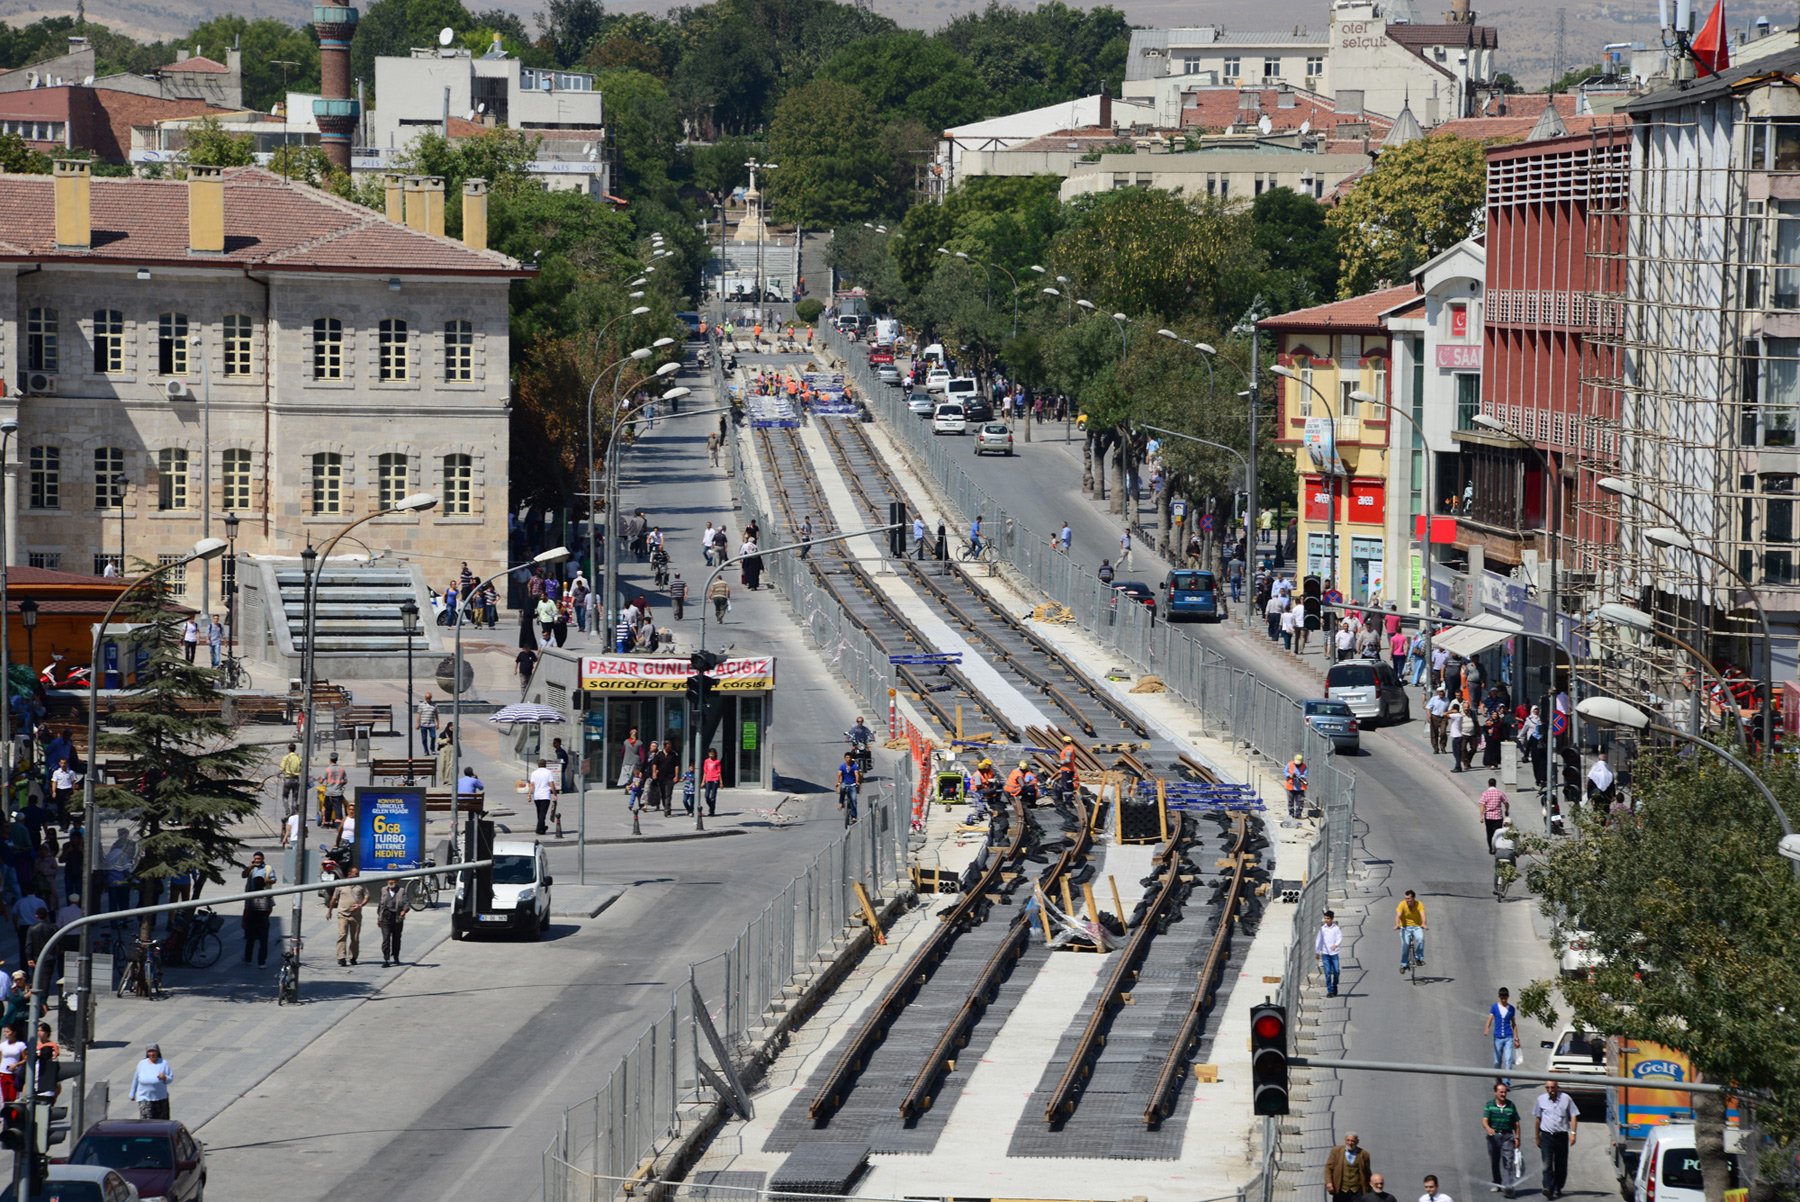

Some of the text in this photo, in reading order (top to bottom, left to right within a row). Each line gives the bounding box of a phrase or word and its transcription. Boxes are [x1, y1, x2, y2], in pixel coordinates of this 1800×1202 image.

[1342, 22, 1368, 34] otel
[1342, 36, 1387, 50] selçuk
[1453, 348, 1481, 366] SAA
[588, 658, 767, 678] PAZAR GÜNLE AÇIĞIZ
[589, 679, 666, 689] sarraflar
[722, 681, 766, 690] çarşısı
[374, 834, 406, 843] TURBO
[374, 849, 406, 858] HEDİYE!
[1638, 1062, 1678, 1075] Golf
